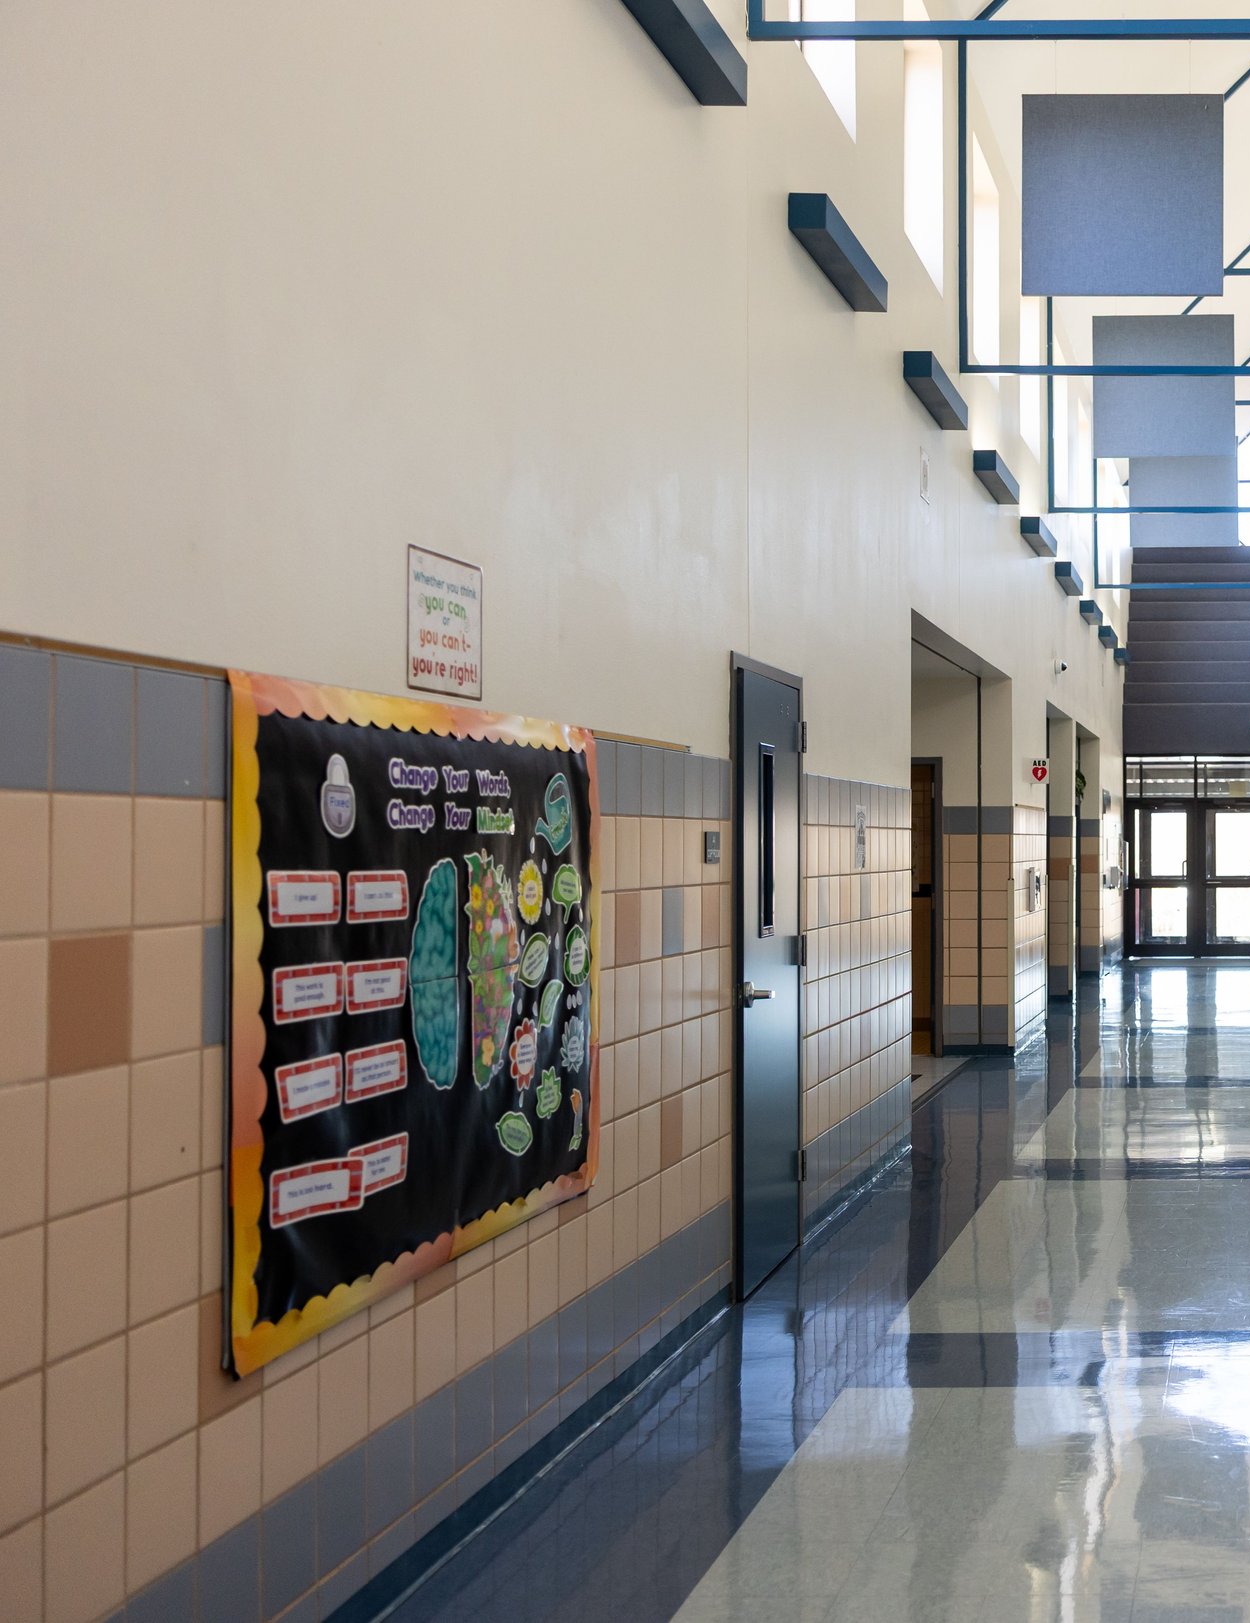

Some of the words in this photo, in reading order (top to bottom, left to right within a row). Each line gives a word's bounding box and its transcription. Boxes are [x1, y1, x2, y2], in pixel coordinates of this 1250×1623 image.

[446, 580, 459, 594] you
[460, 584, 476, 600] think
[425, 594, 444, 615] you
[448, 600, 466, 620] can
[442, 616, 450, 626] or
[420, 628, 438, 648] you
[412, 652, 446, 677] you're
[450, 660, 477, 686] right!
[388, 757, 438, 795] Change
[442, 765, 470, 794] Your
[476, 769, 511, 799] Words,
[387, 798, 436, 834] Change
[445, 801, 472, 830] Your
